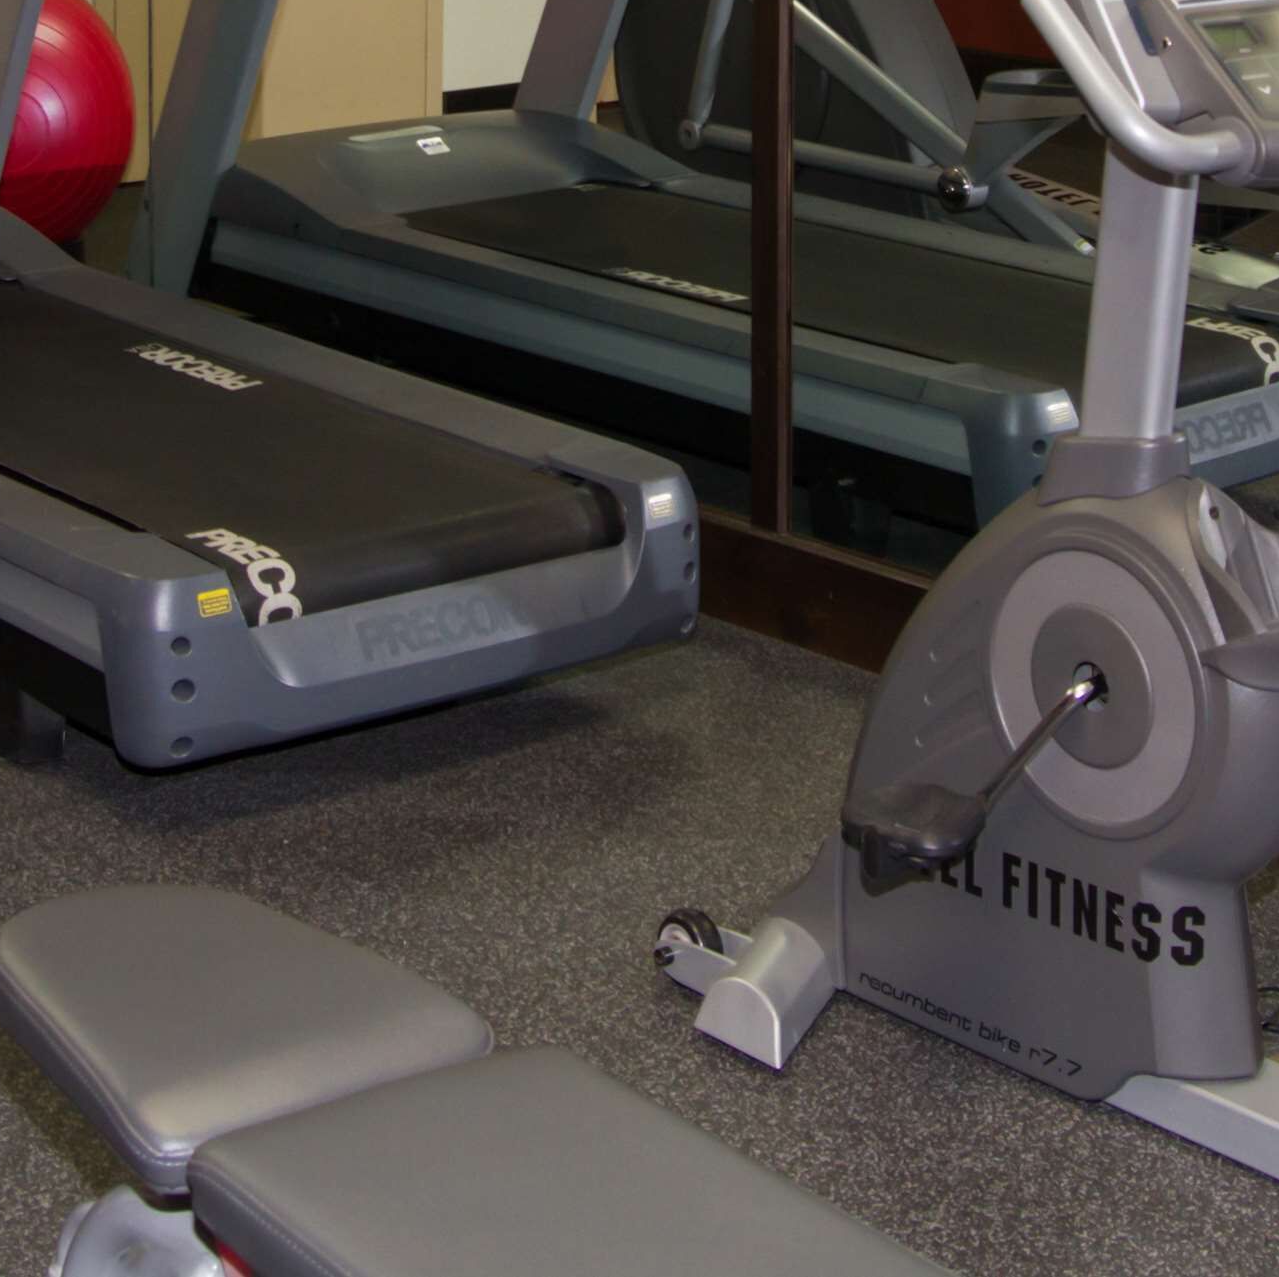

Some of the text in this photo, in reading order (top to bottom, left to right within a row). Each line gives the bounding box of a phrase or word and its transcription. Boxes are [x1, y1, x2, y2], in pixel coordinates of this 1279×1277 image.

[139, 345, 262, 392] PRECOR
[184, 528, 303, 627] PRECO
[1003, 851, 1206, 966] FITNESS
[858, 972, 1083, 1076] recumbent bike r7.7
